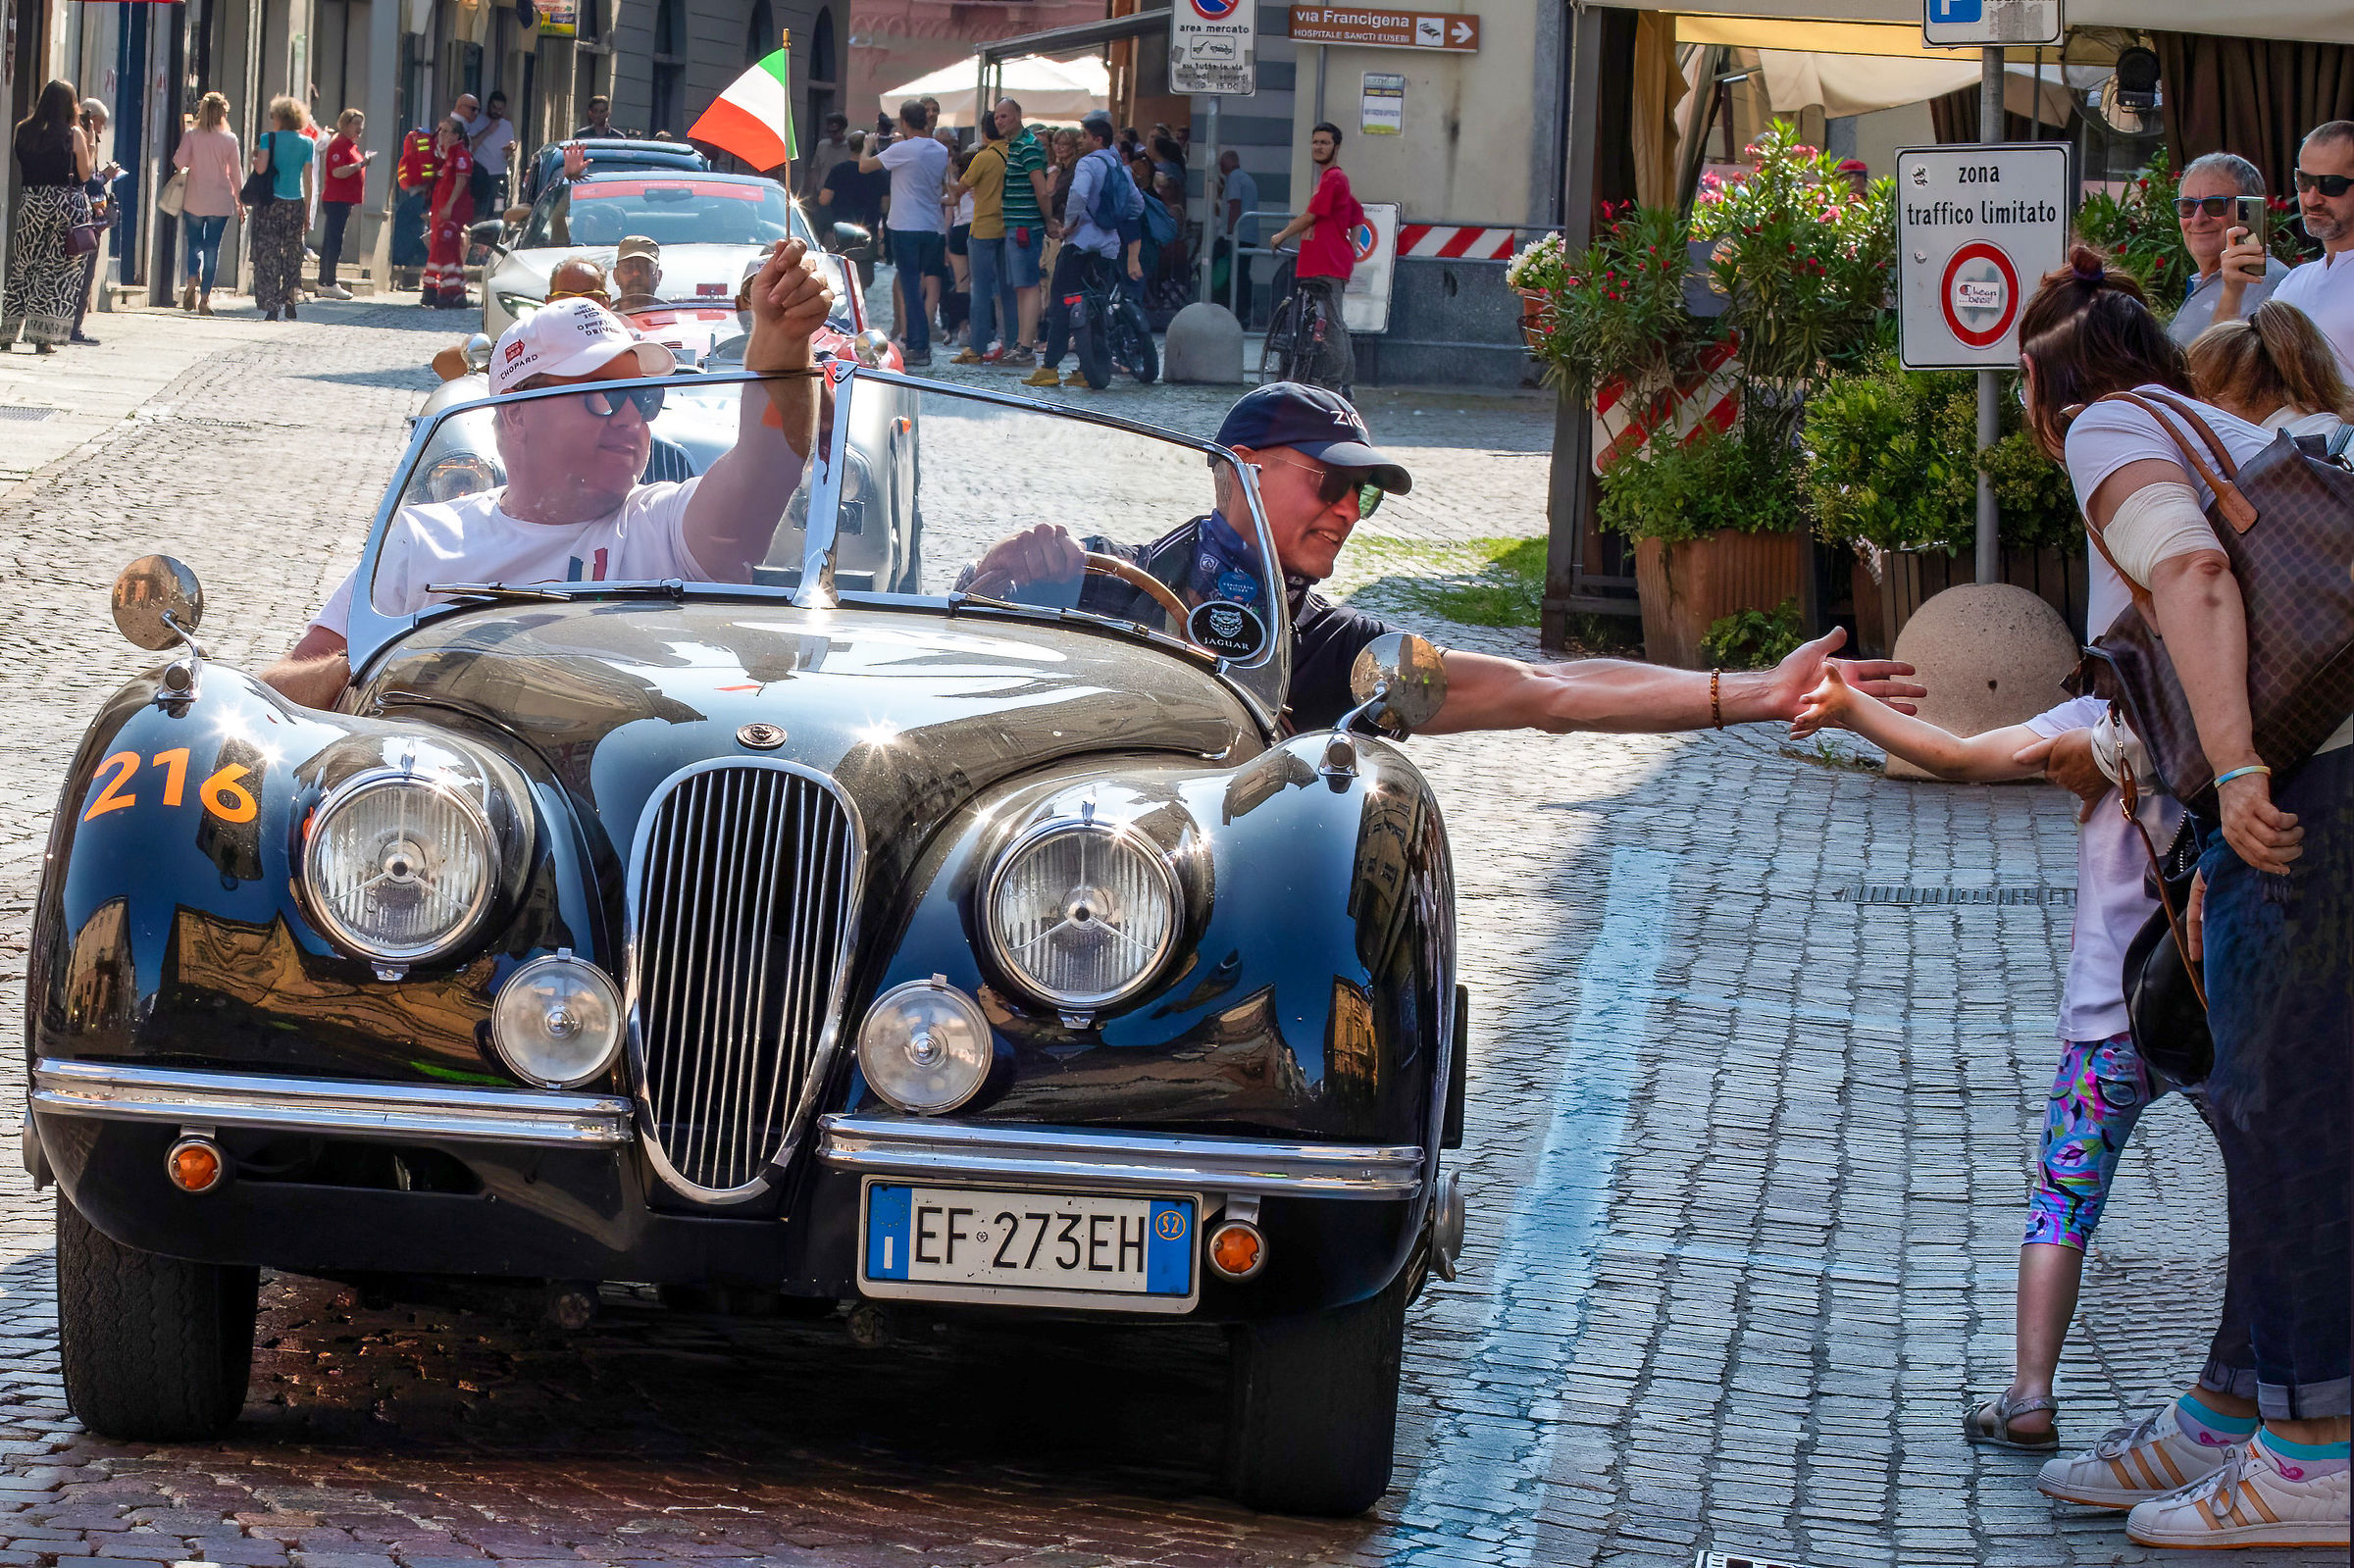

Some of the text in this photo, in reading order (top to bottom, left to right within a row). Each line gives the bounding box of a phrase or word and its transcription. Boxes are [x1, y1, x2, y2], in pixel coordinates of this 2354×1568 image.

[1297, 10, 1409, 28] via Francigena
[1205, 25, 1250, 33] mercato
[1294, 28, 1342, 39] HOSPITALE
[1344, 31, 1375, 41] SANCTI
[1958, 166, 2000, 184] zona
[1907, 200, 2056, 226] traffico limitato
[500, 353, 538, 380] CHOPARD
[1204, 636, 1250, 651] JAGUAR
[83, 747, 258, 824] 216
[914, 1205, 1146, 1273] EF 273EH
